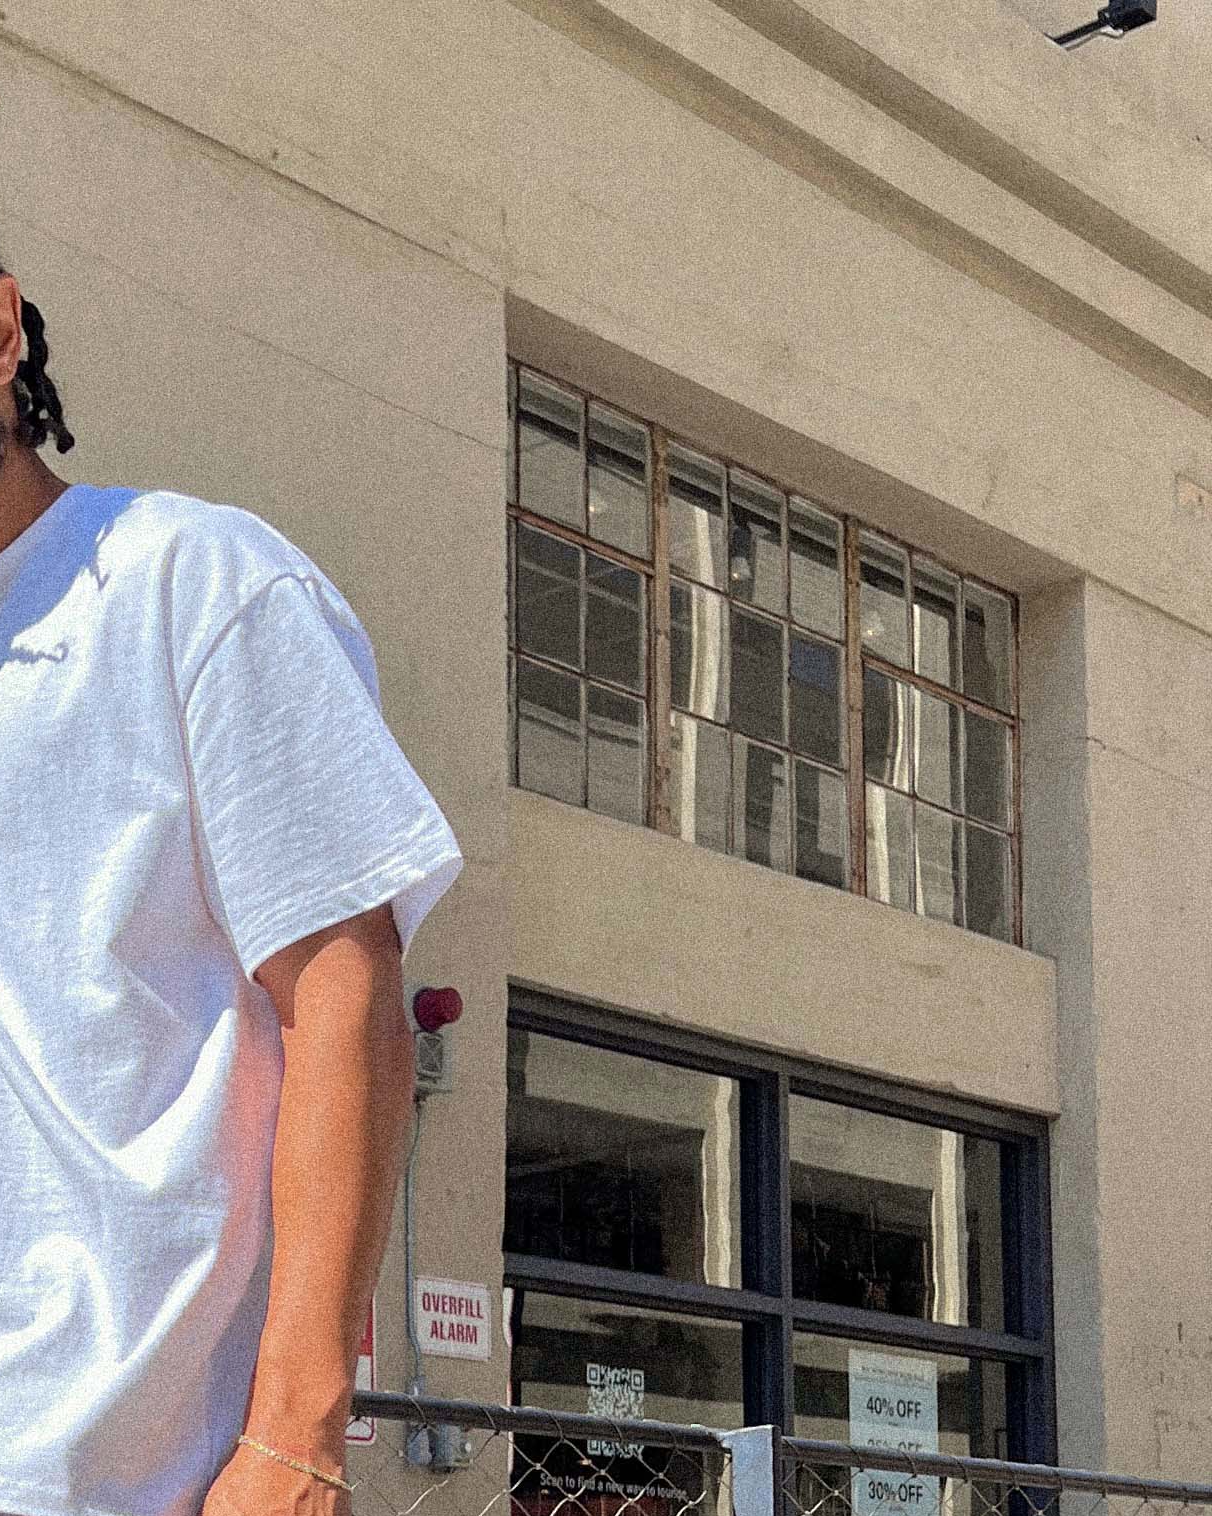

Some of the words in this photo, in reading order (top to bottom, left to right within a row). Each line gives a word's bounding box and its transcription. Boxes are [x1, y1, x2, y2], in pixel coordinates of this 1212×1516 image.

[422, 1292, 484, 1319] OVERFILL
[430, 1320, 478, 1345] ALARM
[866, 1395, 894, 1417] 40%
[896, 1399, 922, 1419] OFF
[540, 1472, 563, 1487] Scan
[565, 1475, 575, 1489] to
[597, 1481, 603, 1492] a
[868, 1480, 896, 1501] 30%
[898, 1483, 923, 1504] OFF
